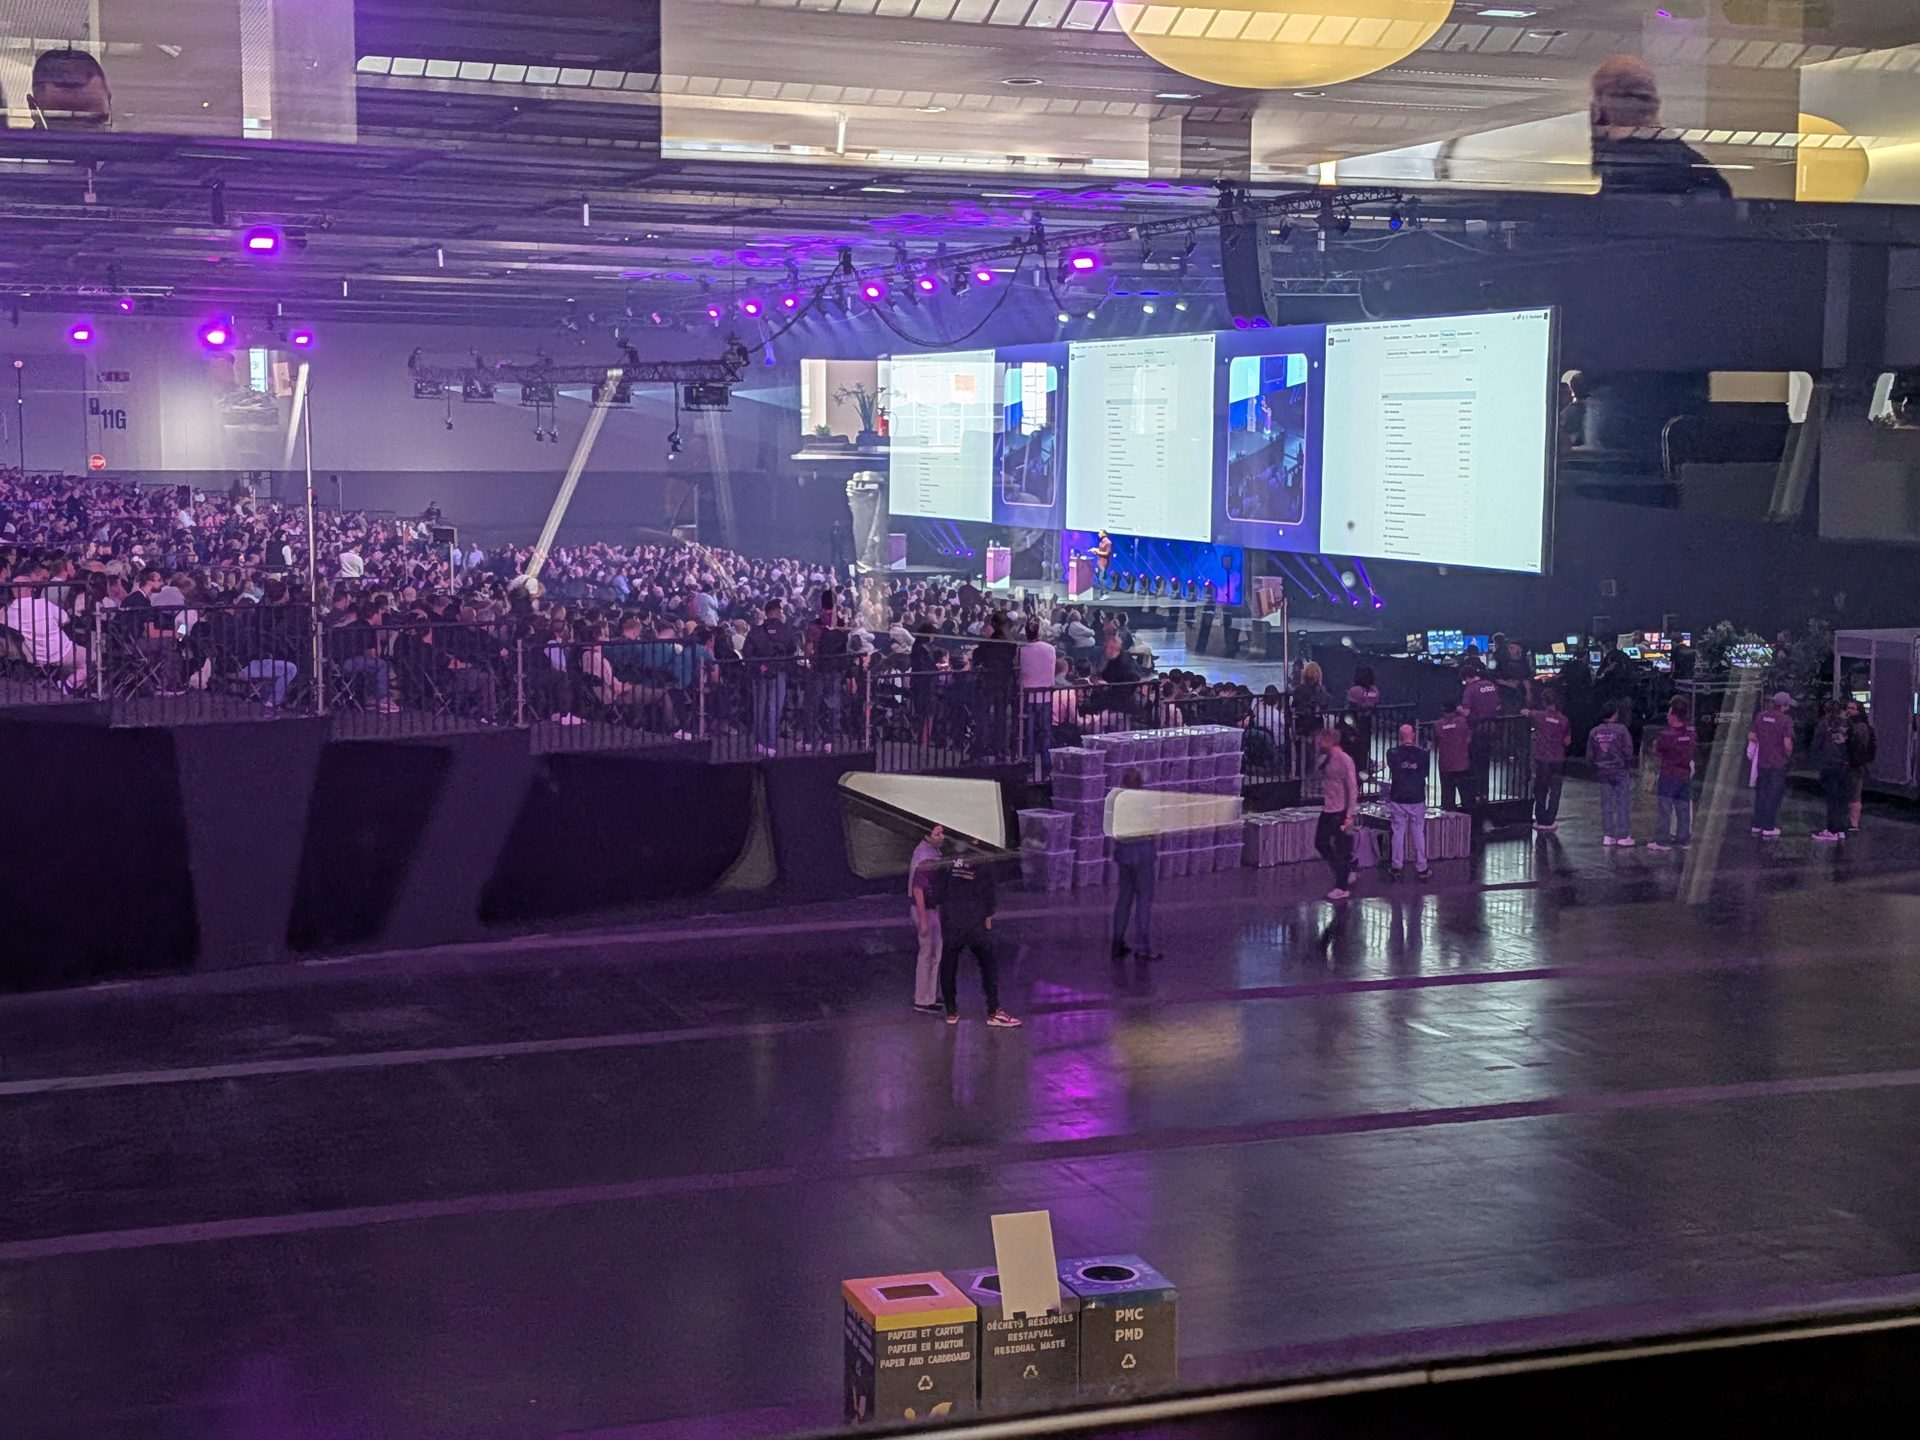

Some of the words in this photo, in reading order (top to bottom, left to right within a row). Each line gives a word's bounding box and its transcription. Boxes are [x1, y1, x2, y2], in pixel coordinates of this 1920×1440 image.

[101, 409, 127, 429] 11G
[1115, 1307, 1144, 1322] PMC
[887, 1330, 917, 1341] PAPIER
[921, 1328, 931, 1338] ET
[934, 1325, 964, 1337] CARTON
[1007, 1328, 1054, 1342] RESTAFVAL
[1115, 1328, 1144, 1342] PMD
[887, 1343, 917, 1355] PAPIER
[921, 1341, 931, 1352] EN
[934, 1339, 964, 1350] KARTON
[994, 1343, 1036, 1356] RESIDUAL
[1040, 1339, 1066, 1351] WASTE
[880, 1358, 905, 1369] PAPER
[909, 1356, 924, 1367] AND
[928, 1351, 971, 1364] CARDBOARD
